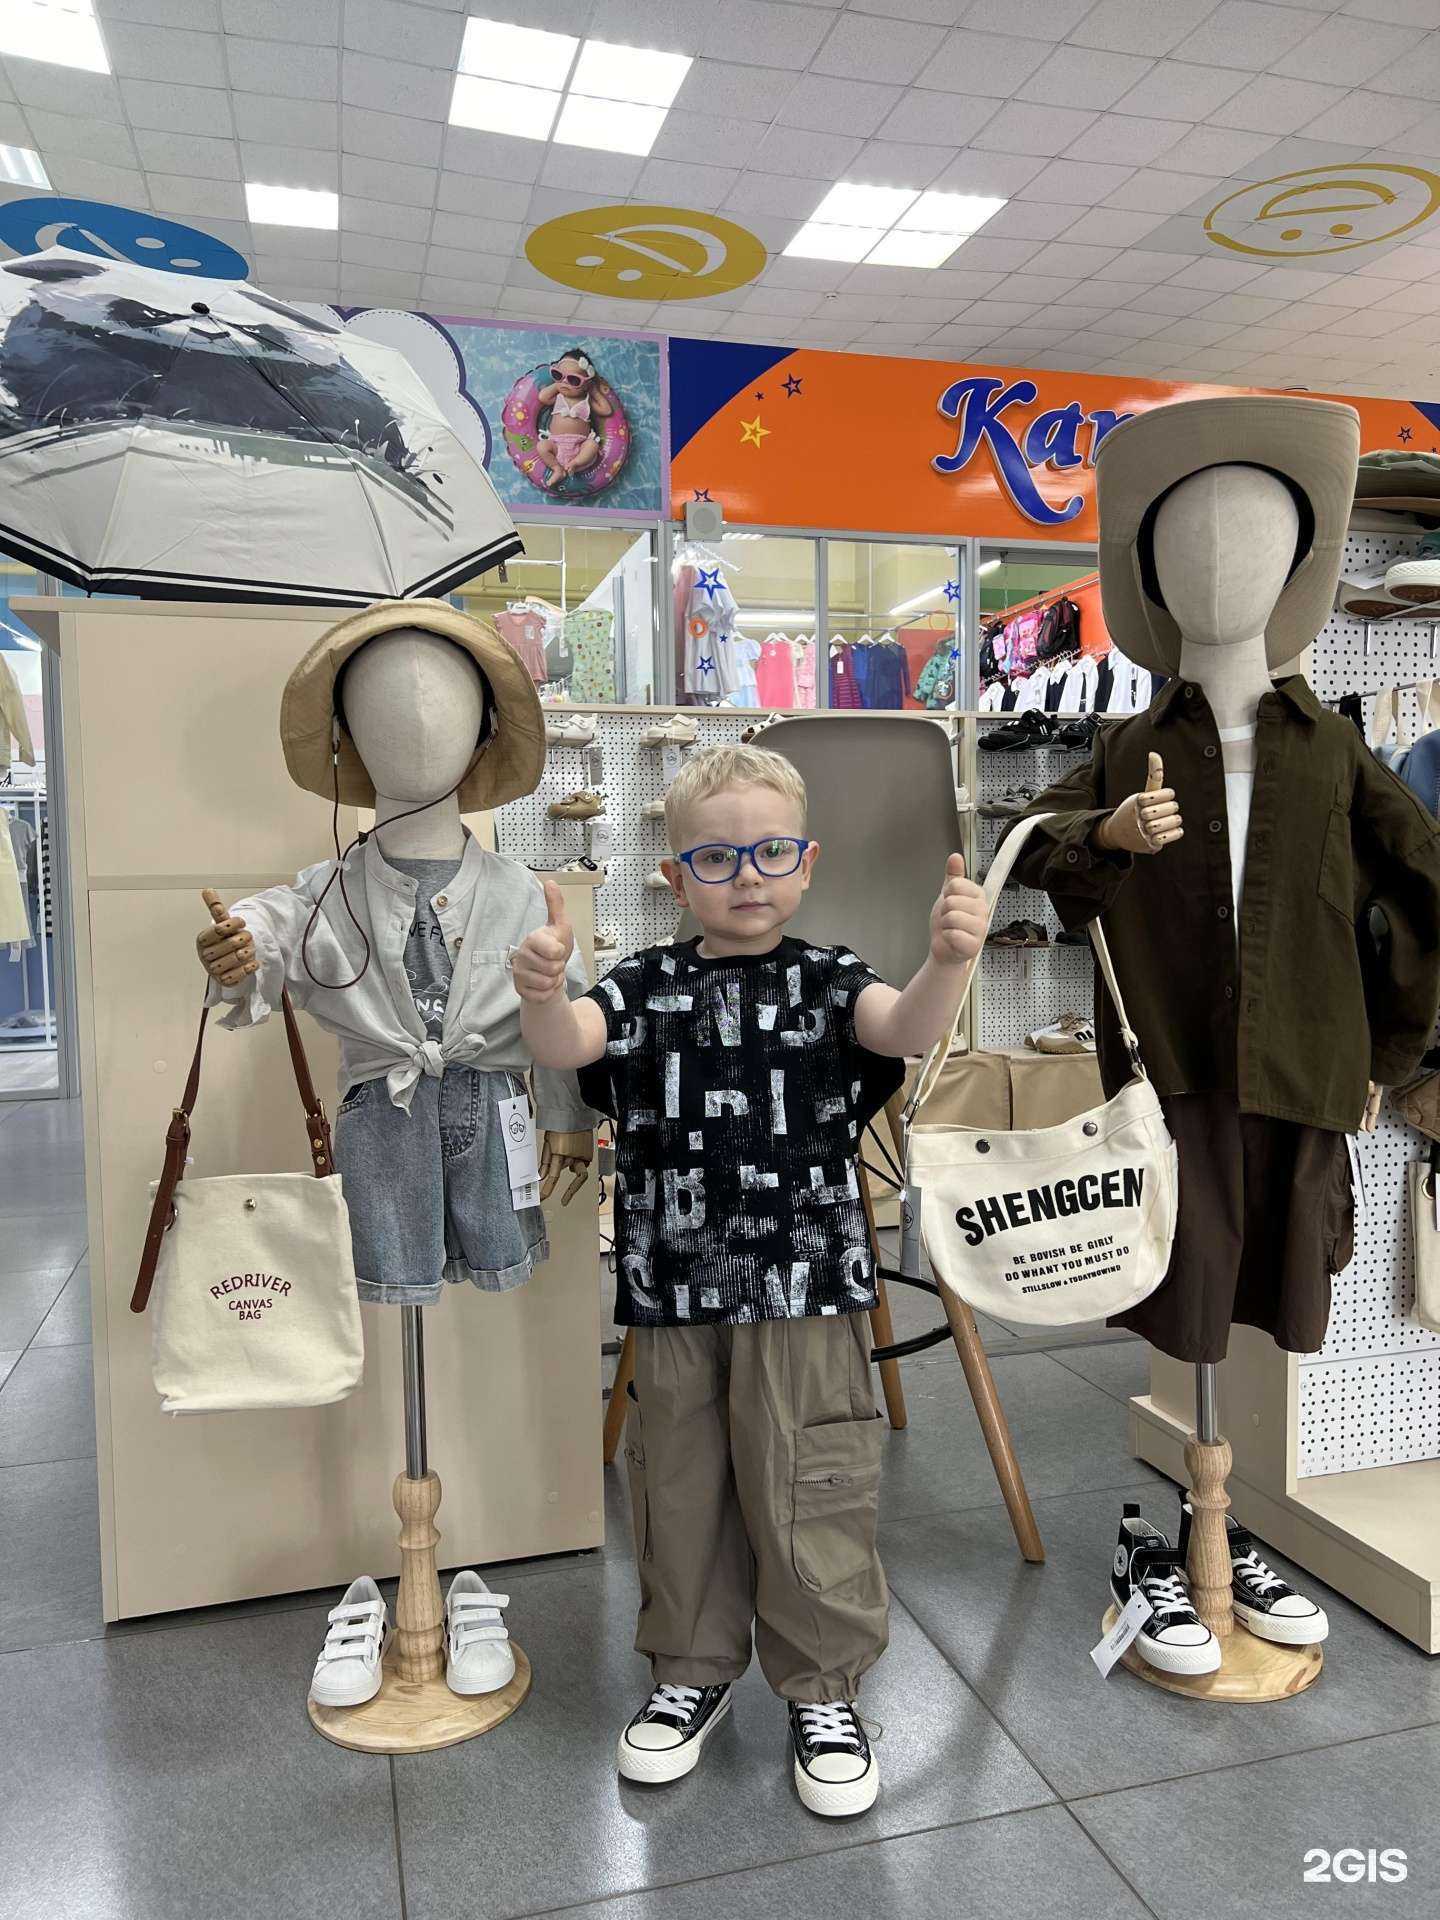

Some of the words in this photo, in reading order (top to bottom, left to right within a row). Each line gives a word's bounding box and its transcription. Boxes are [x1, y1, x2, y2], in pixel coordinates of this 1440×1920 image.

[955, 1167, 1145, 1246] SHENGCEN
[1013, 1255, 1026, 1265] BE
[1070, 1243, 1084, 1254] BE
[1087, 1235, 1114, 1250] GIRLY
[1005, 1271, 1020, 1282] DO
[1021, 1264, 1060, 1279] WHANT
[1061, 1259, 1083, 1271] YOU
[1085, 1250, 1114, 1266] MUST
[1116, 1246, 1130, 1257] DO
[210, 1273, 292, 1300] REDRIVER
[1022, 1279, 1062, 1294] STILLSLOW
[228, 1298, 273, 1310] CANVAS
[239, 1310, 262, 1321] BAG
